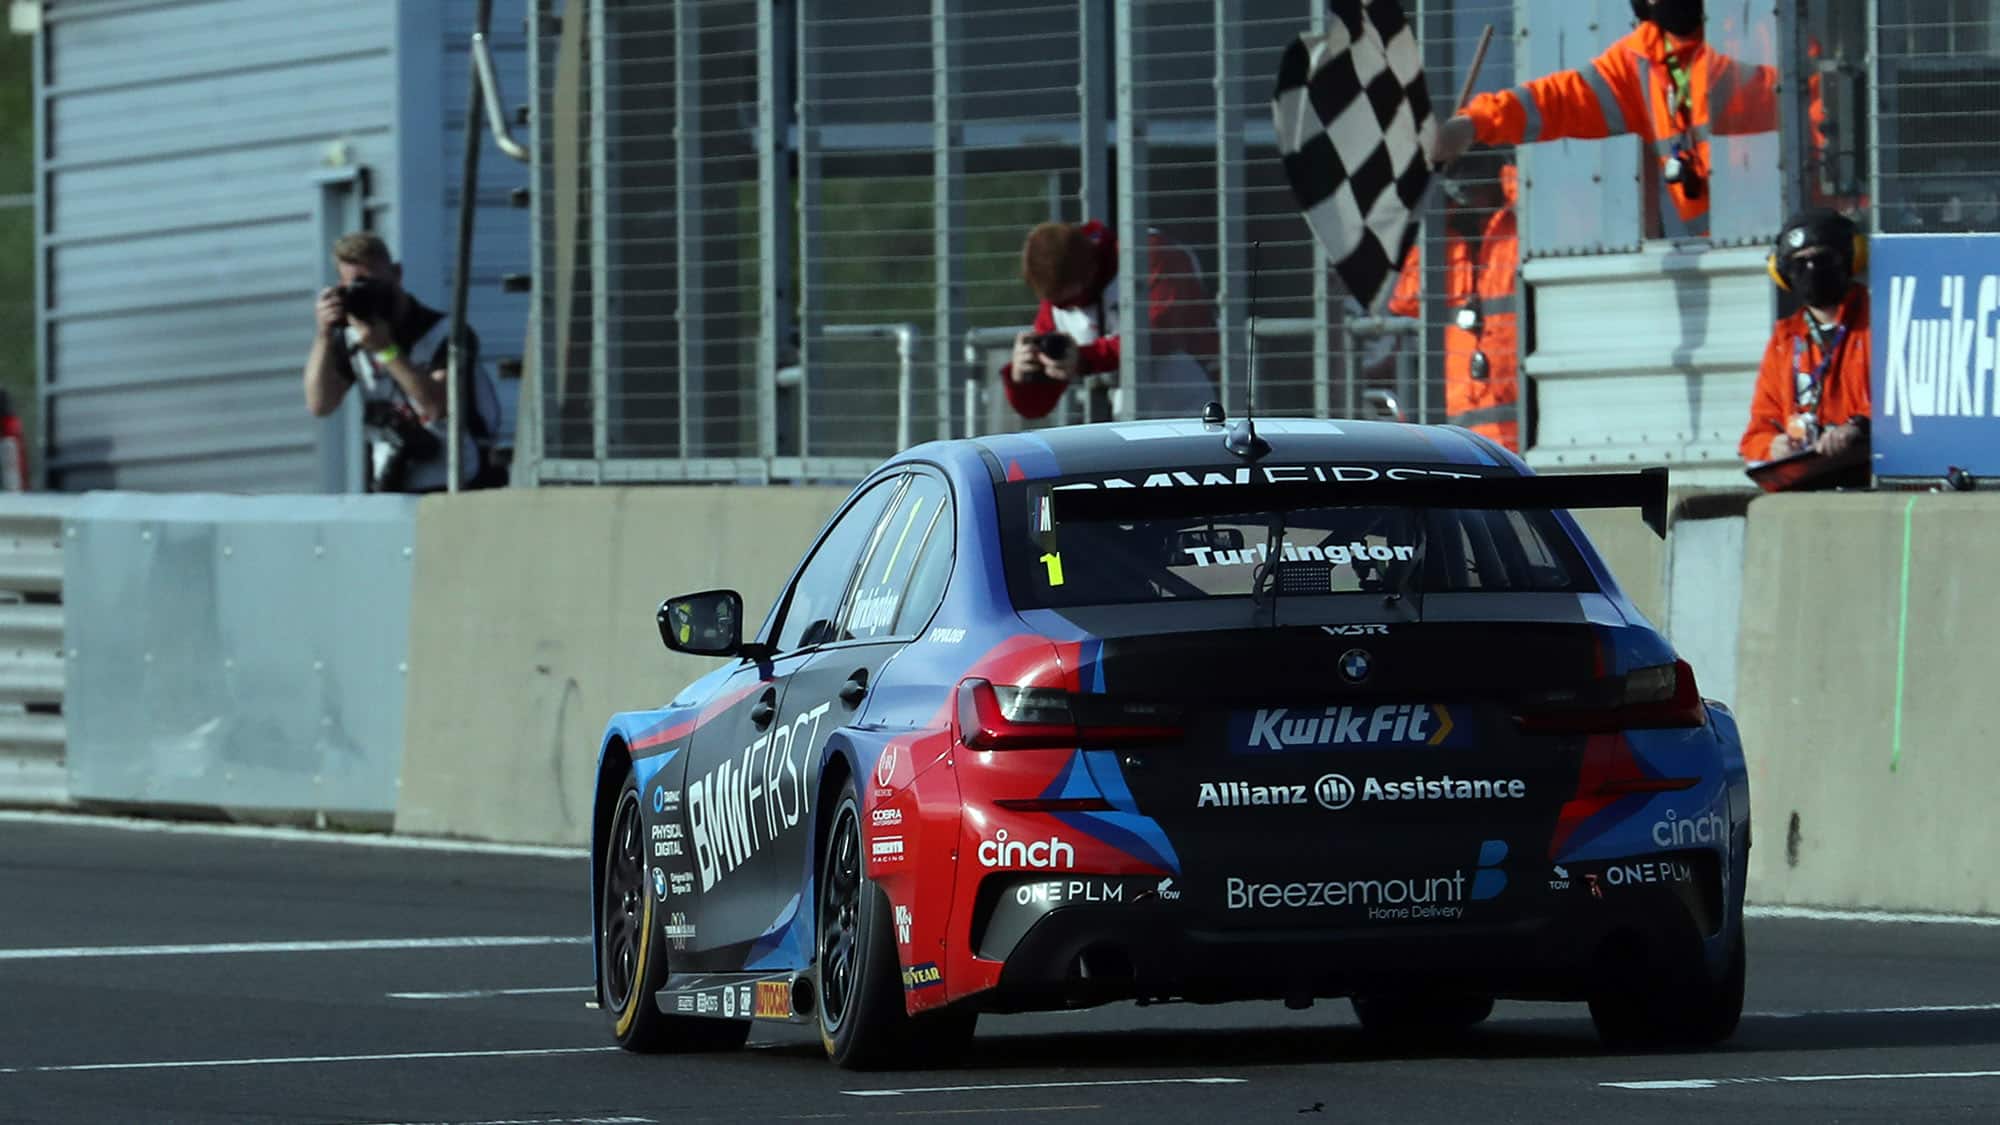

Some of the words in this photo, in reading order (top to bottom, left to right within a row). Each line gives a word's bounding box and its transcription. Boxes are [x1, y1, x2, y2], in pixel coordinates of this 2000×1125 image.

[1040, 552, 1064, 586] 1
[1321, 623, 1390, 636] WSR
[1197, 782, 1308, 808] Allianz
[1361, 775, 1527, 801] Assistance
[872, 809, 902, 821] COBRA
[1652, 809, 1724, 848] cinch
[978, 829, 1075, 869] cinch
[1550, 881, 1570, 890] TOW
[1606, 863, 1657, 885] ONE
[1659, 862, 1692, 883] PLM
[1016, 882, 1063, 906] ONE
[1068, 881, 1124, 903] PLM
[1159, 890, 1181, 901] TOW
[1226, 870, 1466, 909] Breezemount
[1368, 907, 1408, 920] Home
[1411, 905, 1464, 920] Delivery
